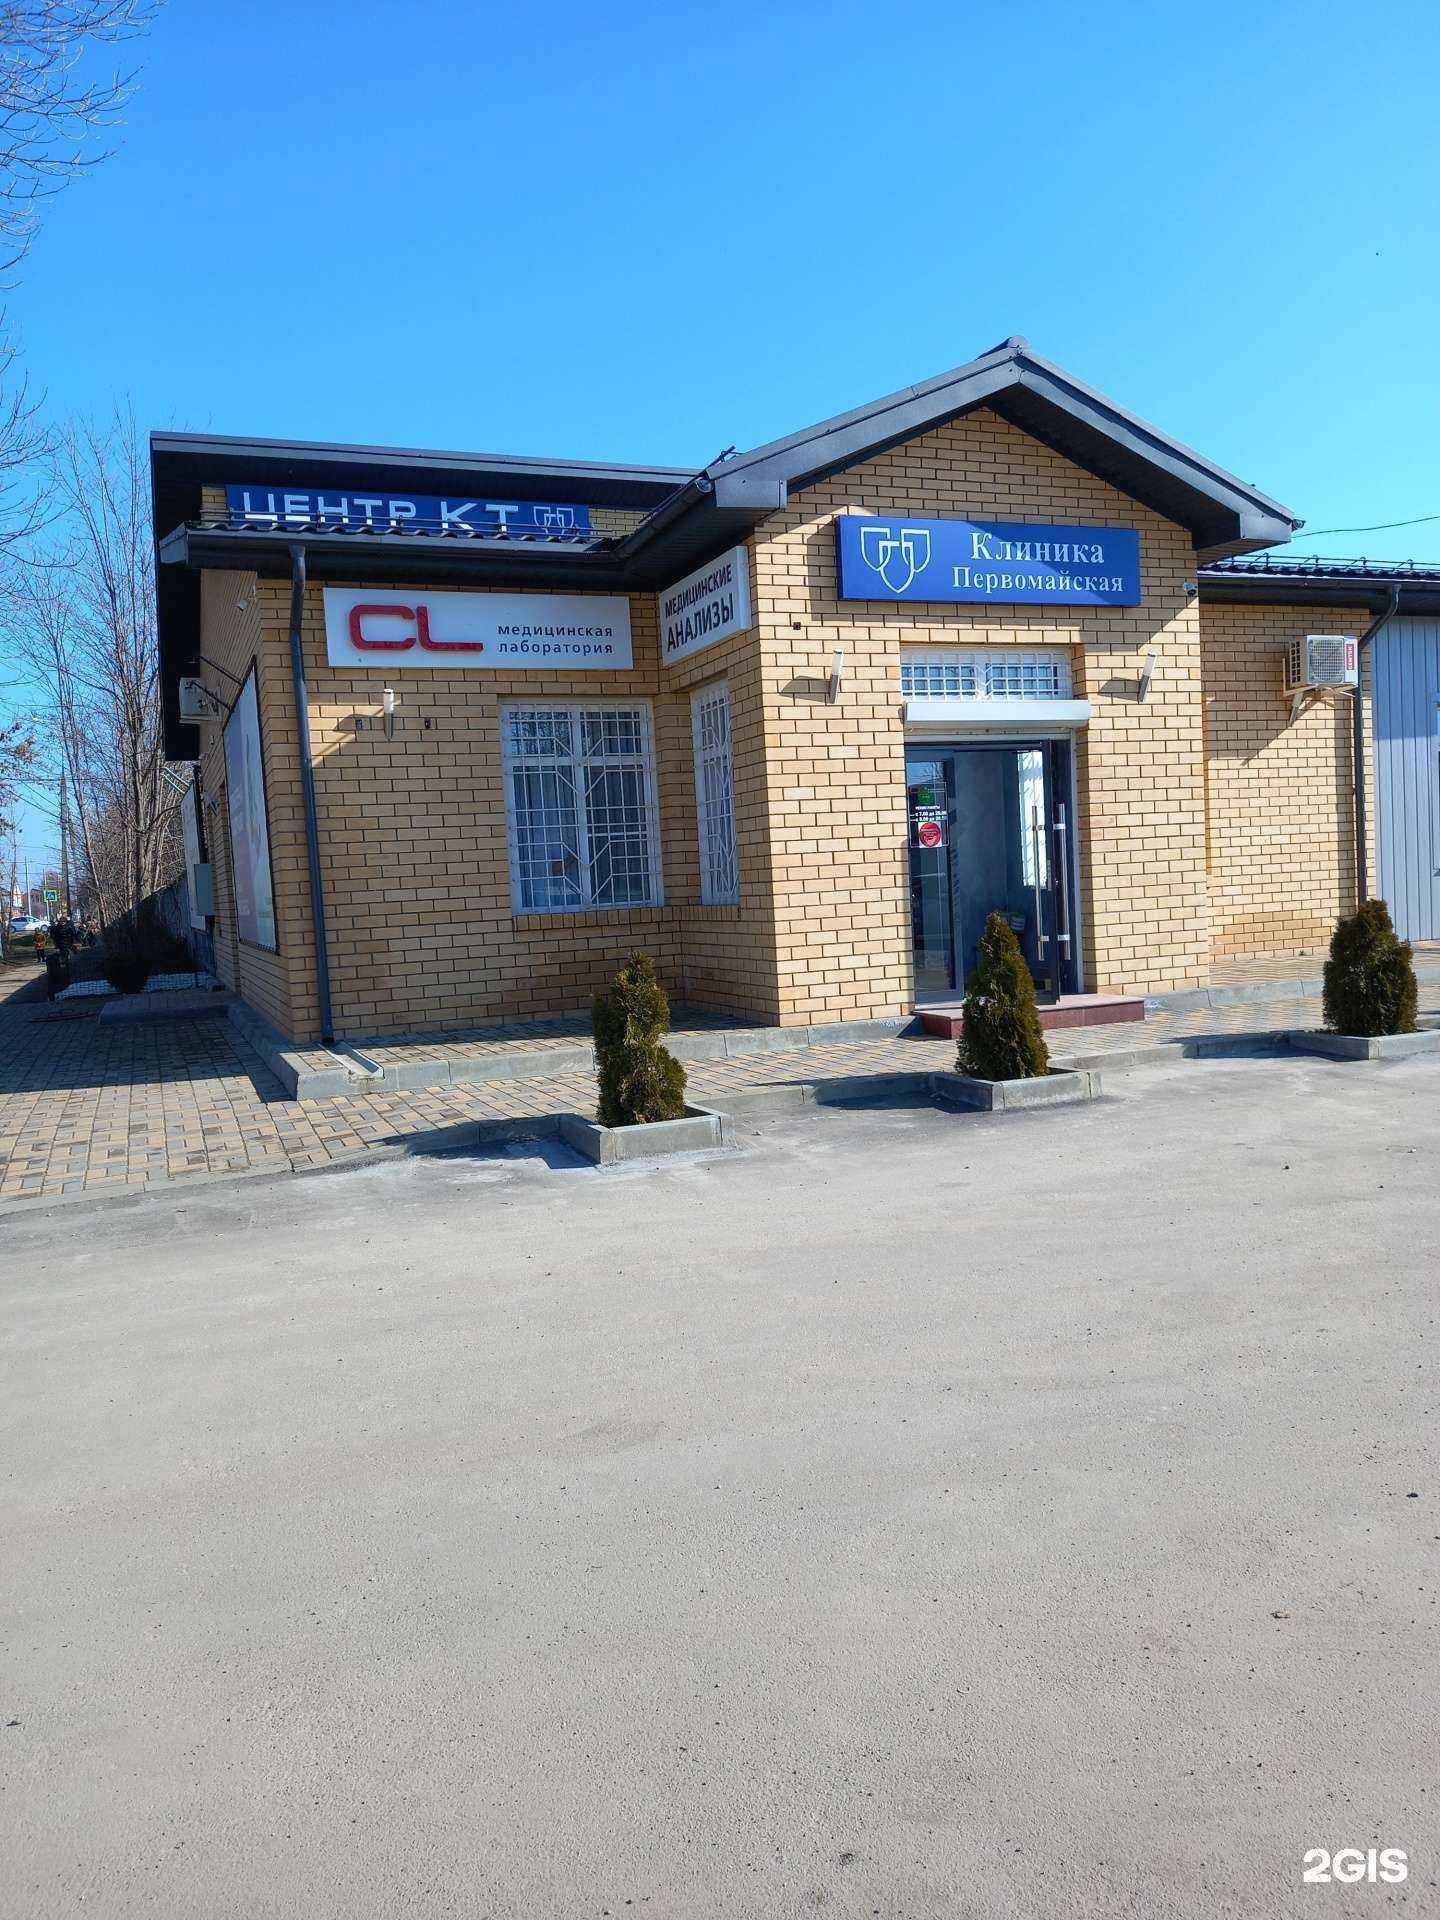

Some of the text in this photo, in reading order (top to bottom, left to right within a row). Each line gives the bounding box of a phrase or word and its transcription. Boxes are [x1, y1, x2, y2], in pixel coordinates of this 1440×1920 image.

[243, 492, 519, 533] ЦЕНТР КТ
[970, 531, 1105, 564] Клиника
[665, 564, 732, 618] МЕДИЦИНСКИЕ
[952, 566, 1124, 594] Первомайская
[348, 604, 484, 651] CL
[498, 625, 613, 638] медицинская
[667, 592, 734, 652] АНАЛИЗЫ
[498, 639, 613, 656] лаборатория
